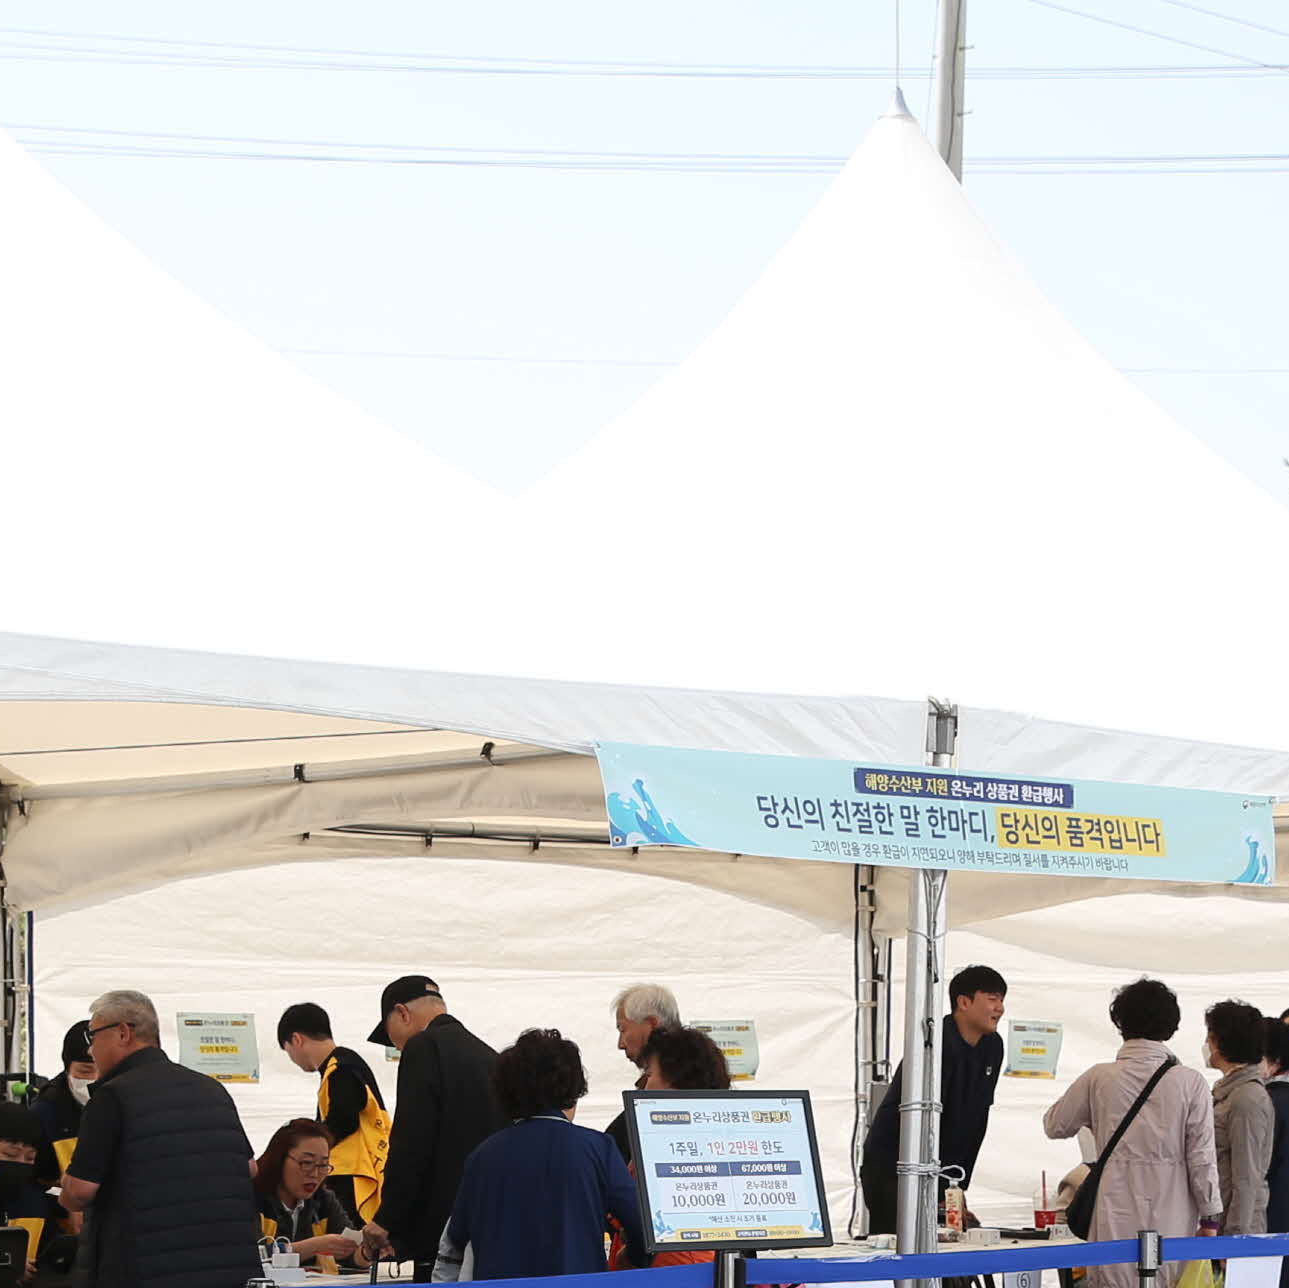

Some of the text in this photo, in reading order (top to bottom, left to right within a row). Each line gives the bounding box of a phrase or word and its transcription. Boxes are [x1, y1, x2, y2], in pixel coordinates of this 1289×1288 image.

[865, 774, 1064, 804] 해양수산부 지원 온누리 상품권 환급행사
[757, 795, 1160, 852] 당신의 친절한 말 한마디, 당신의 품격입니다
[812, 840, 1128, 871] 고객이 많을 경우 환급이 지연되오니 양해 부탁드리며 질서를 지켜주시기 바랍니다
[693, 1111, 750, 1123] 온누리상품권
[670, 1141, 784, 1157] 1주일, 1인 2만원 한도
[671, 1164, 717, 1174] 34,000원 이상
[741, 1163, 786, 1173] 67,000원 이상
[676, 1182, 718, 1191] 온누리상품권
[746, 1180, 788, 1189] 온누리상품권
[672, 1194, 726, 1208] 10,000원
[744, 1192, 796, 1205] 20,000원
